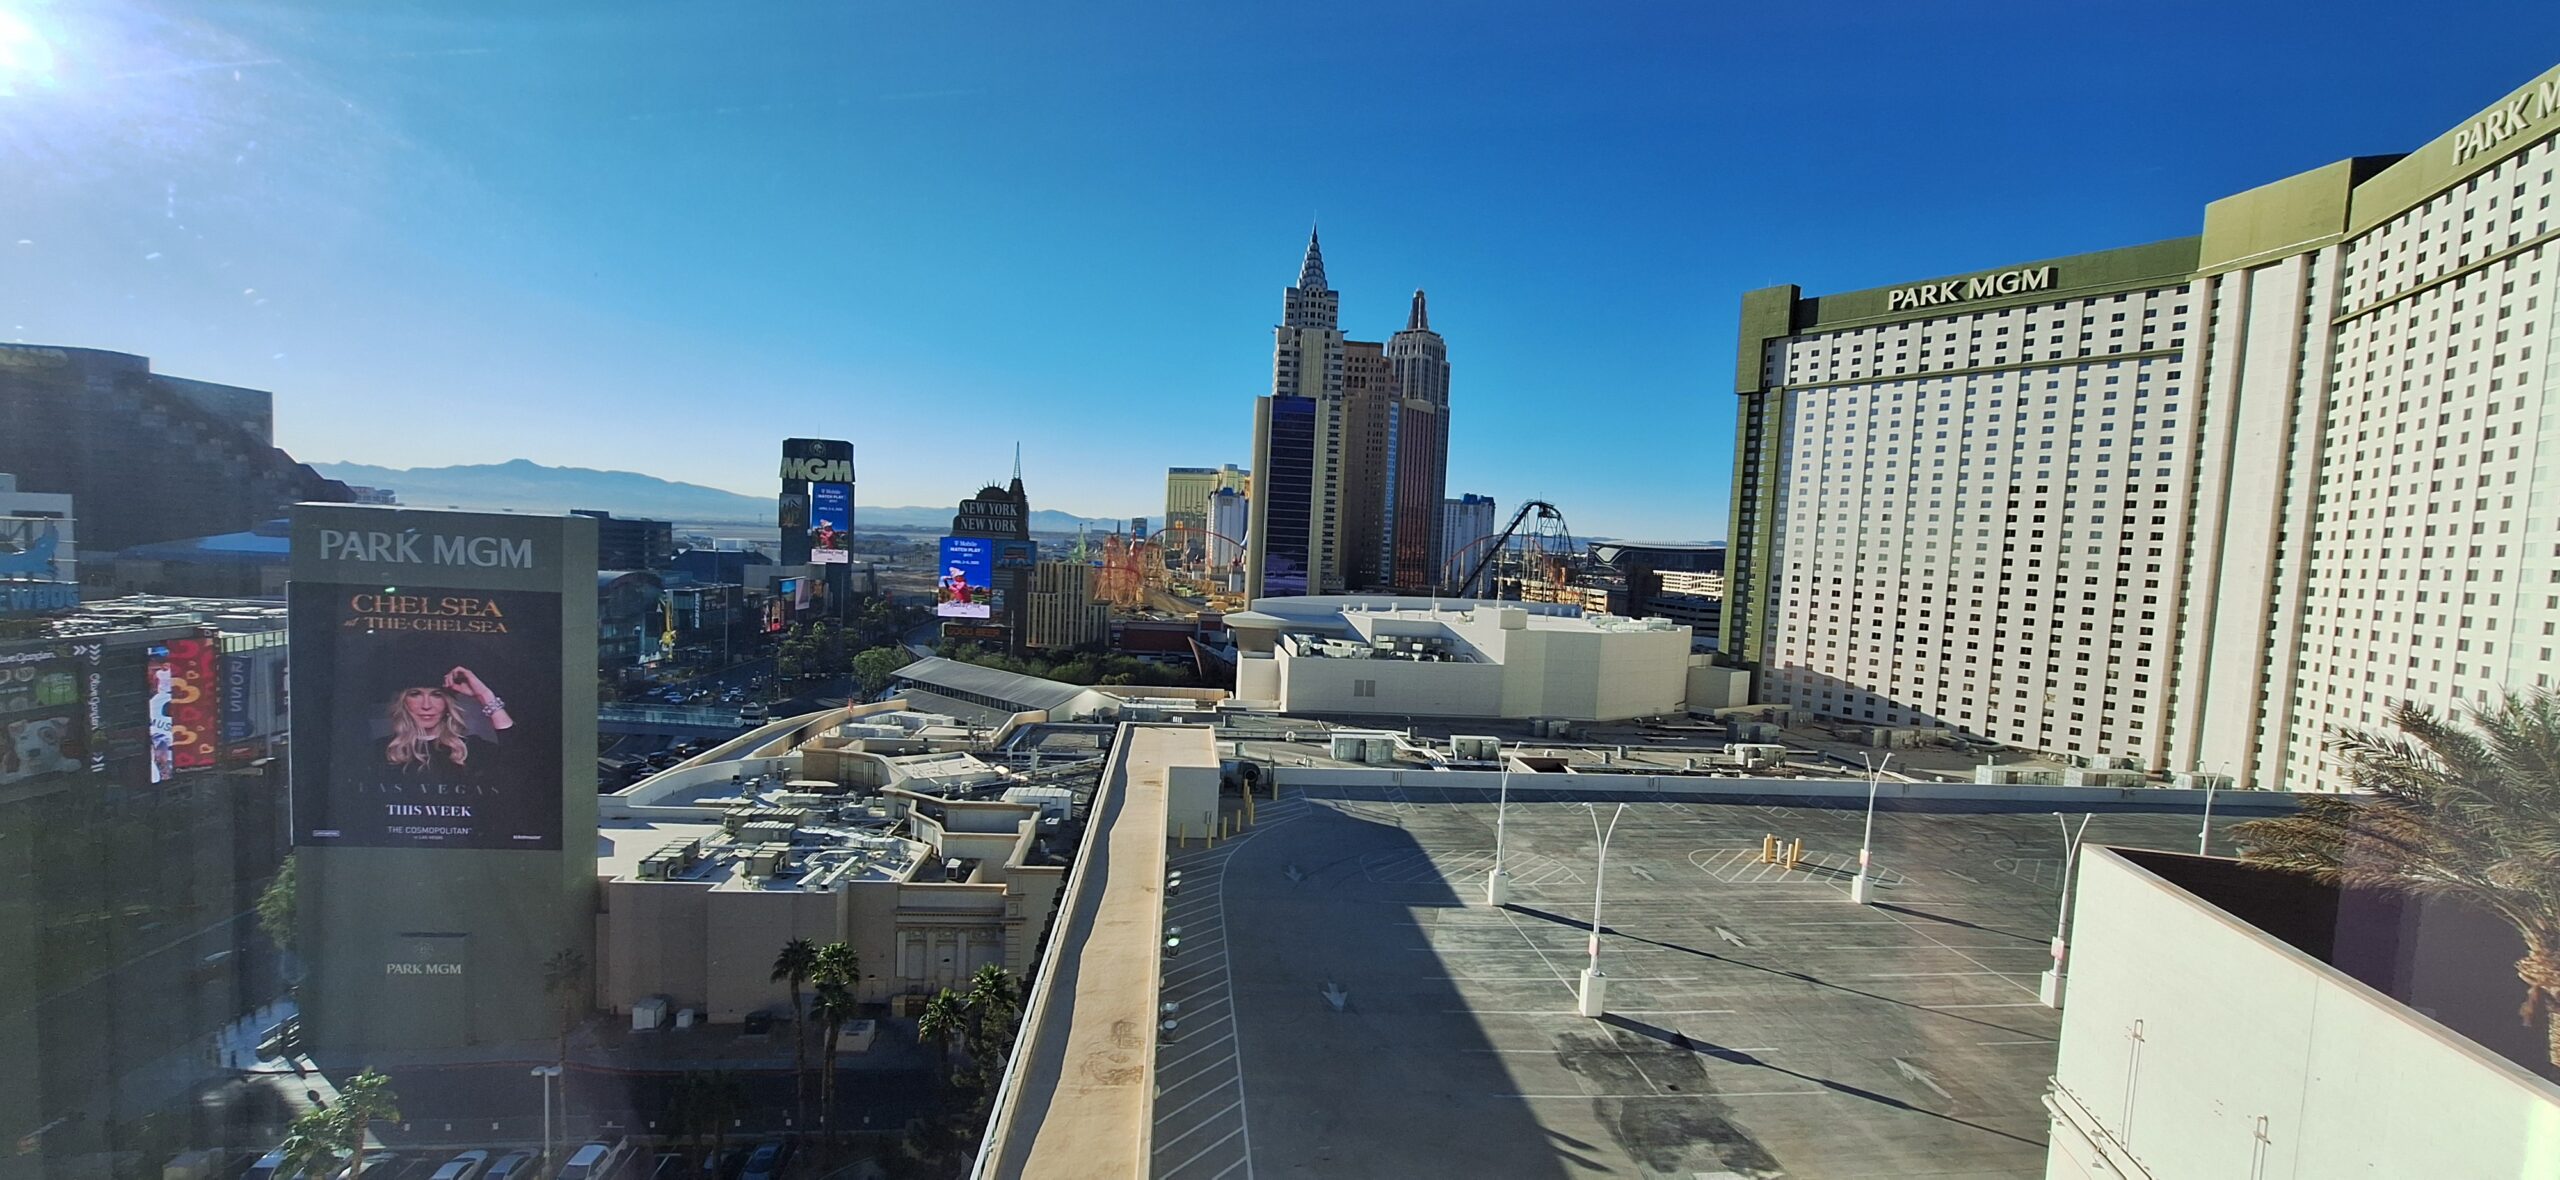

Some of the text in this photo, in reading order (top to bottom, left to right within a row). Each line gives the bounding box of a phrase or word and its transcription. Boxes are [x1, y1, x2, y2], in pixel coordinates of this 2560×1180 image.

[2452, 92, 2533, 167] PARK
[1888, 266, 2053, 311] PARK MGM
[780, 457, 853, 482] MGM
[961, 502, 1018, 516] NEW YORK
[960, 517, 1017, 532] NEW YORK
[320, 529, 533, 569] PARK MGM
[351, 593, 503, 618] CHELSEA
[412, 619, 508, 634] CHELSEA
[231, 661, 245, 712] ROSS
[358, 783, 500, 795] LAS VEGAS
[386, 803, 472, 817] THIS WEEK
[387, 825, 470, 835] THE COSMOPOLITAN
[387, 963, 462, 974] PARK MGM
